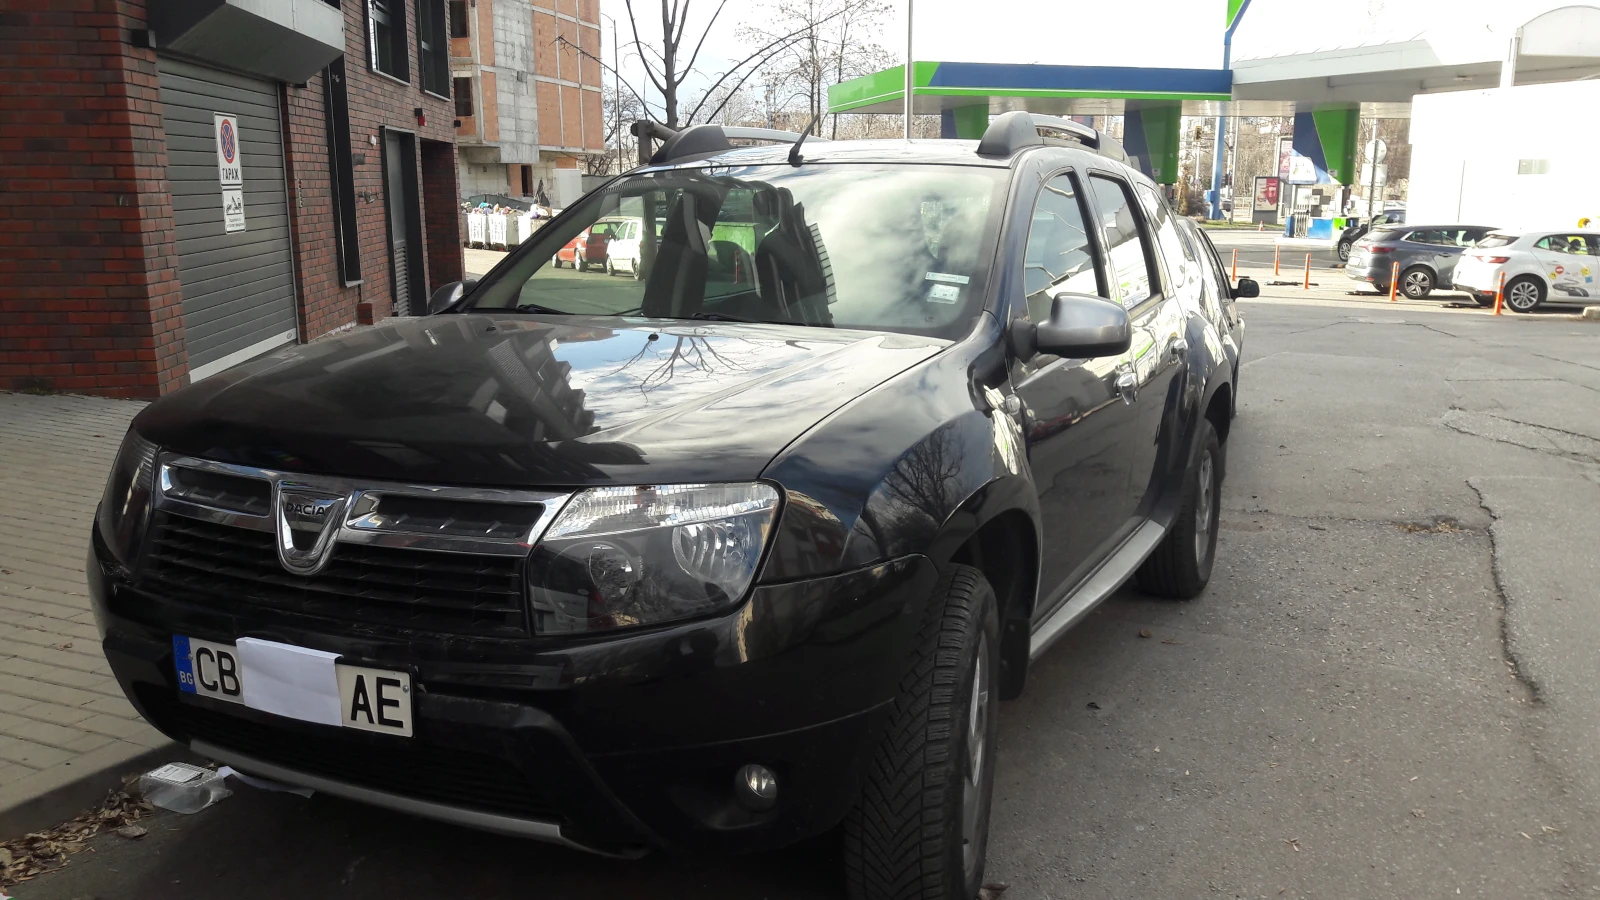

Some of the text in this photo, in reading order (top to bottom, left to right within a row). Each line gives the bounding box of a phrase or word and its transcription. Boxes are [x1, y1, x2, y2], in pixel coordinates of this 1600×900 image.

[222, 168, 239, 180] ГАРАЖ
[285, 502, 325, 516] DACIA
[180, 670, 194, 684] BG
[195, 647, 404, 728] CB AE
